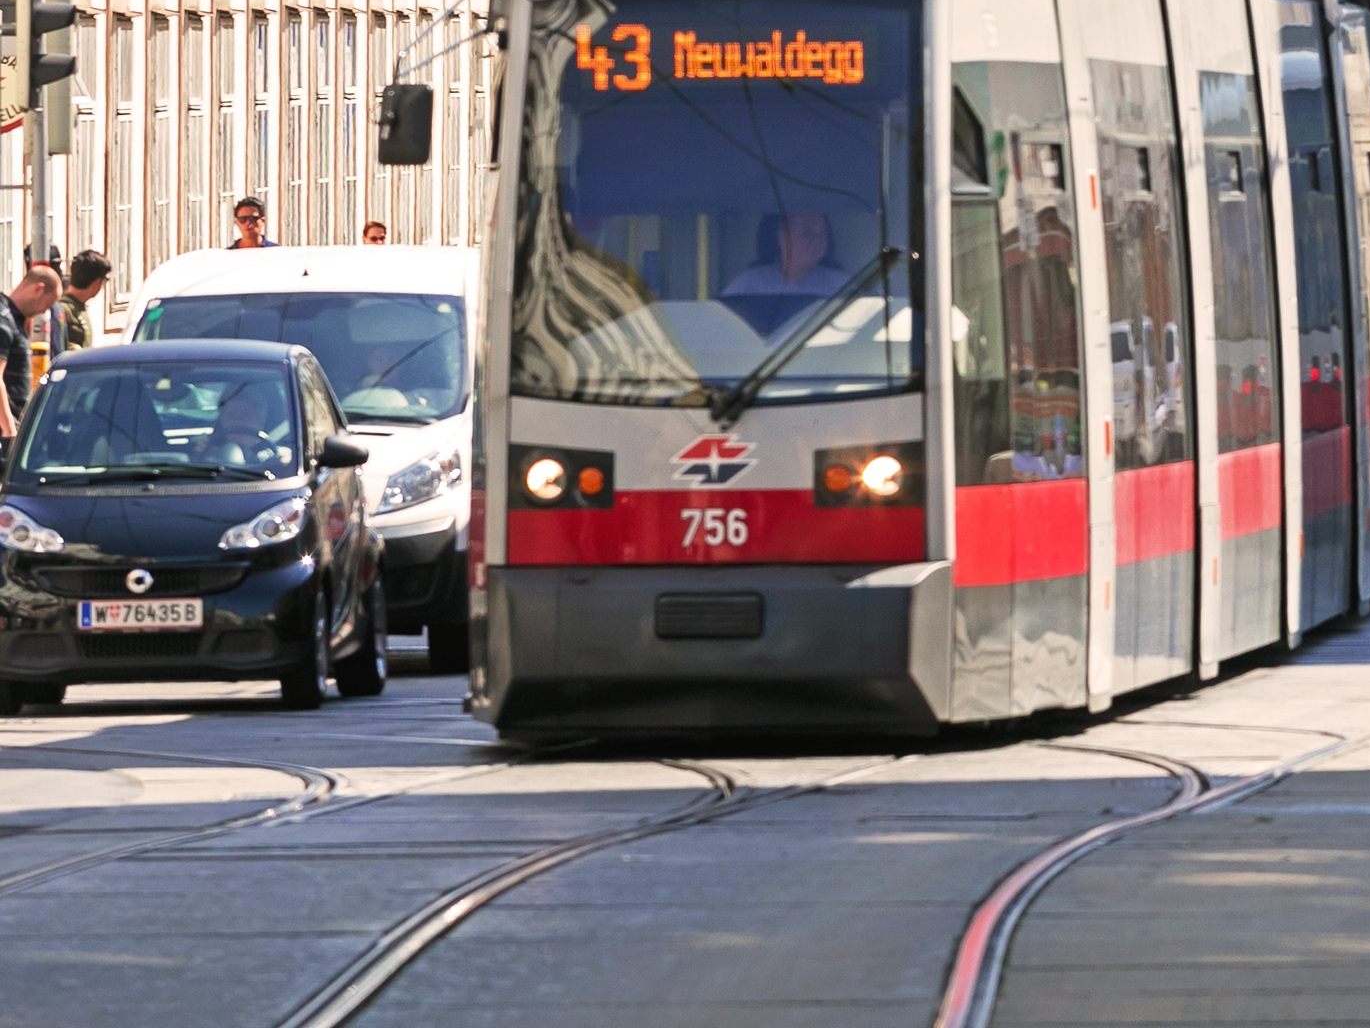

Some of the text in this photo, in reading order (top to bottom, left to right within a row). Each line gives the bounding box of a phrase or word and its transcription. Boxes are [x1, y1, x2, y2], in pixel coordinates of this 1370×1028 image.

[576, 23, 864, 91] 43 Neuwaldegg
[681, 508, 748, 548] 756
